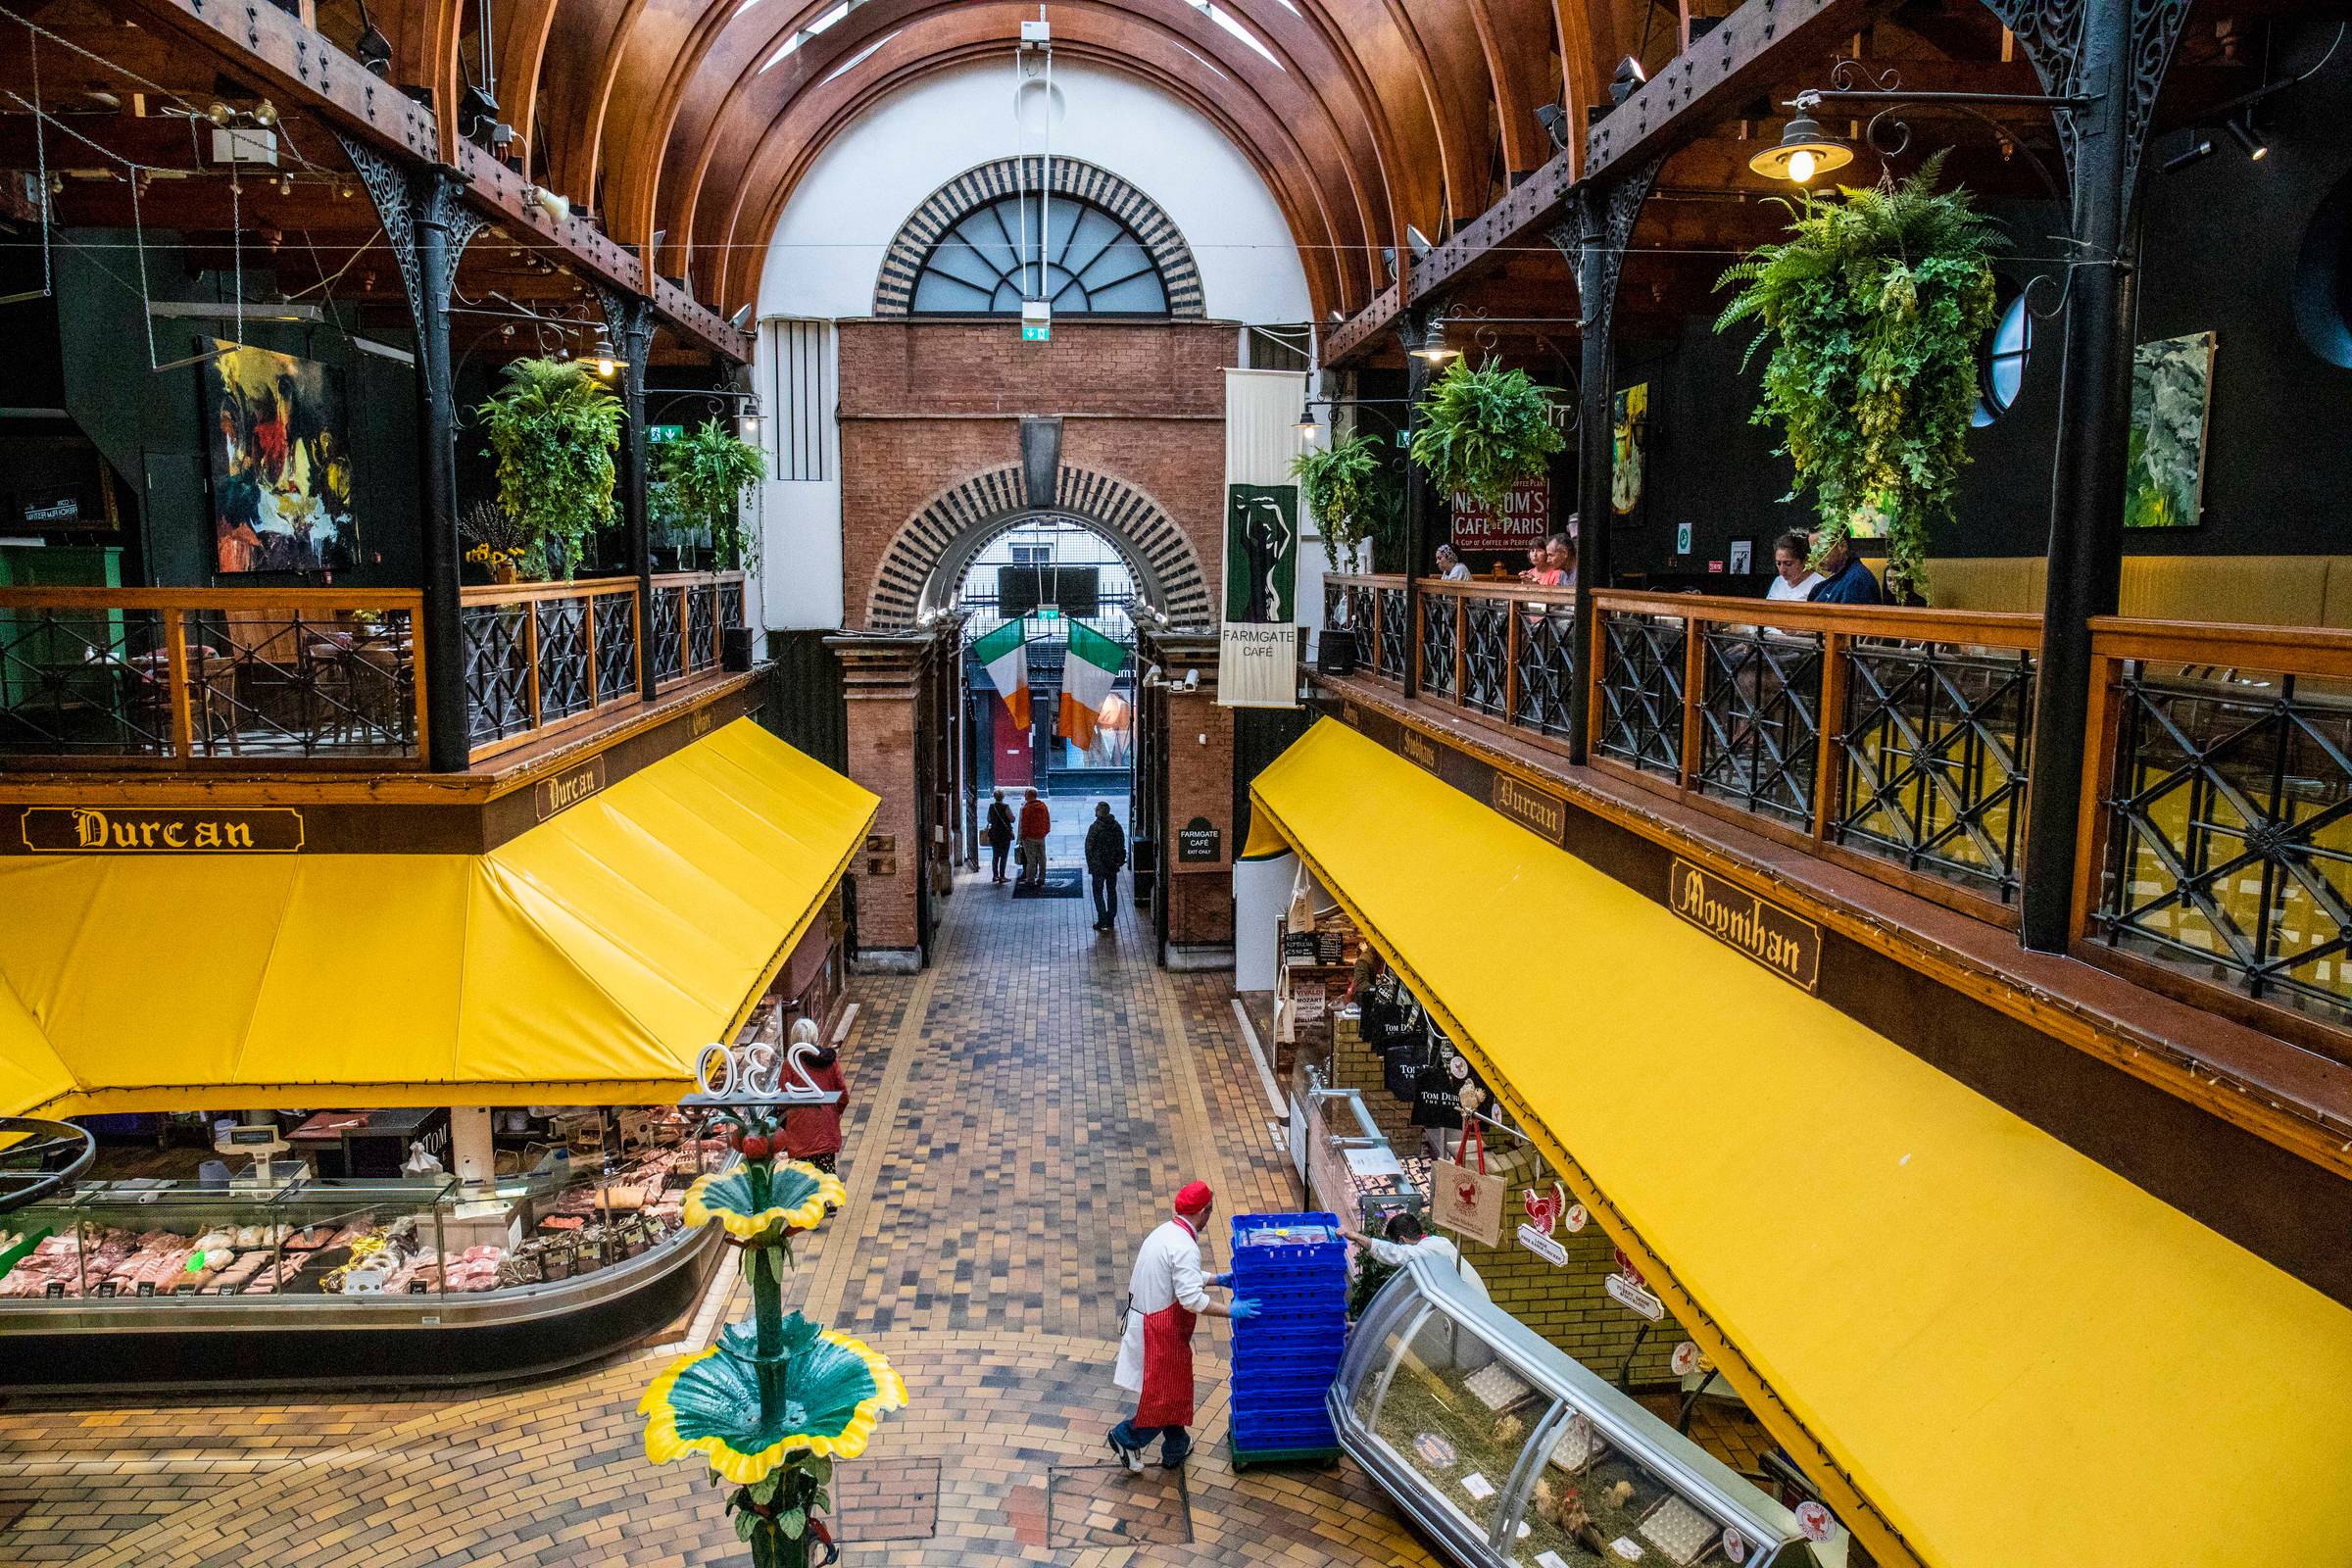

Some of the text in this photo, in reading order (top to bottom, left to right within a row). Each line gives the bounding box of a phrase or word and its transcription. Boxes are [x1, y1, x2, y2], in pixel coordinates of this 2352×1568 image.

[1455, 490, 1545, 514] NEWOM'S
[1503, 517, 1544, 535] PARIS
[1223, 629, 1295, 643] FARMGATE
[1243, 645, 1273, 658] CAFÉ
[549, 769, 595, 811] Durcan
[1498, 777, 1557, 831] Durcan
[72, 808, 255, 848] Durcan
[1678, 870, 1800, 974] Moynihan
[1399, 1064, 1415, 1074] TO
[1421, 1091, 1460, 1102] TOM DUR
[423, 1123, 448, 1153] TOM
